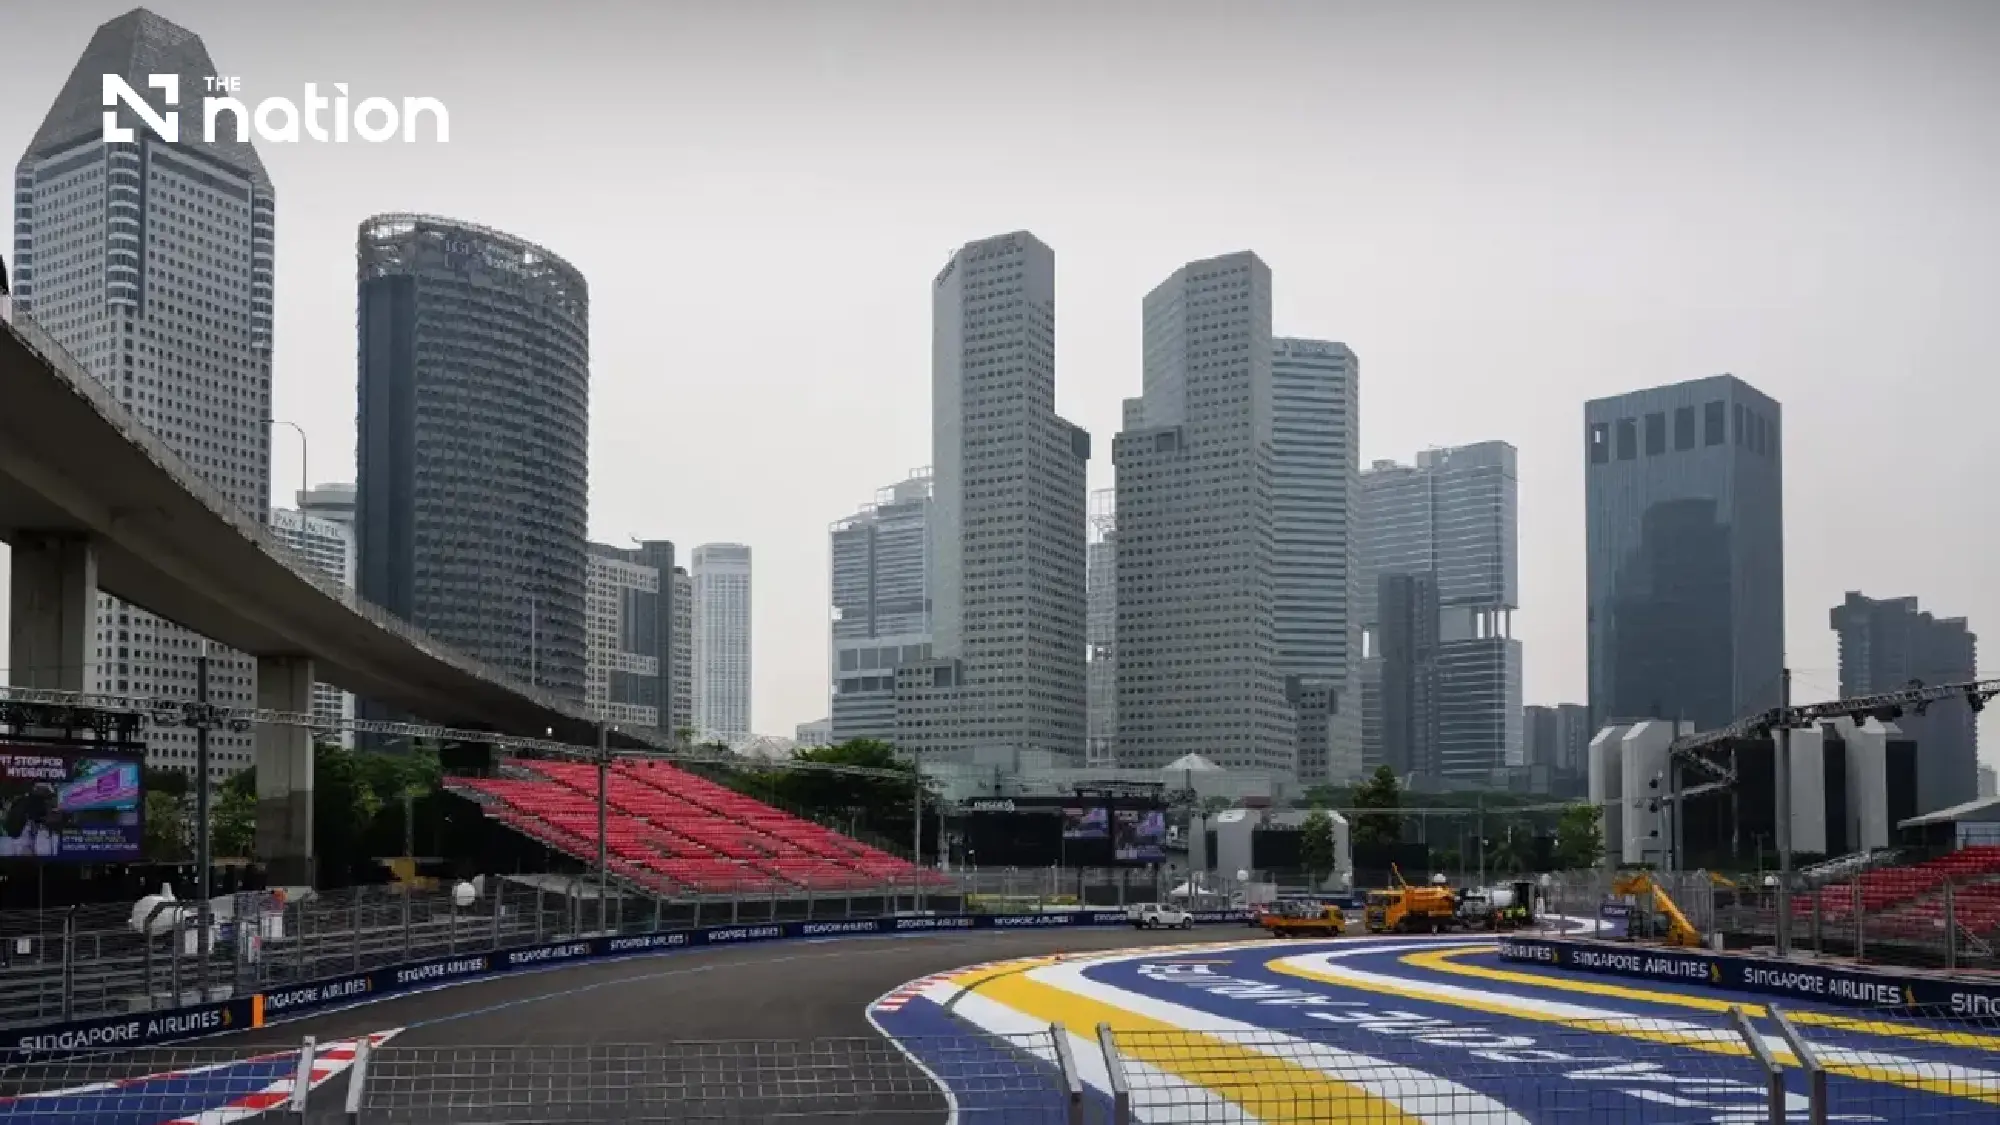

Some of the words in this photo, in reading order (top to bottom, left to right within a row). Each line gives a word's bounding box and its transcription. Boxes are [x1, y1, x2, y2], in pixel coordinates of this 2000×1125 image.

[300, 518, 339, 537] ACIFIC
[6, 768, 67, 779] HYDRATION
[14, 756, 40, 766] STOP
[42, 757, 63, 769] FOR
[398, 963, 444, 982] SINGAPORE
[447, 956, 483, 974] AIRLINES
[1573, 951, 1640, 971] SINGAPORE
[1645, 959, 1708, 978] AIRLINES
[264, 988, 318, 1010] INGAPORE
[322, 978, 366, 1000] AIRLINES
[1744, 967, 1823, 994] SINGAPORE
[1829, 979, 1900, 1004] AIRLINES
[19, 1022, 140, 1055] SINGAPORE
[146, 1010, 220, 1037] AIRLINES
